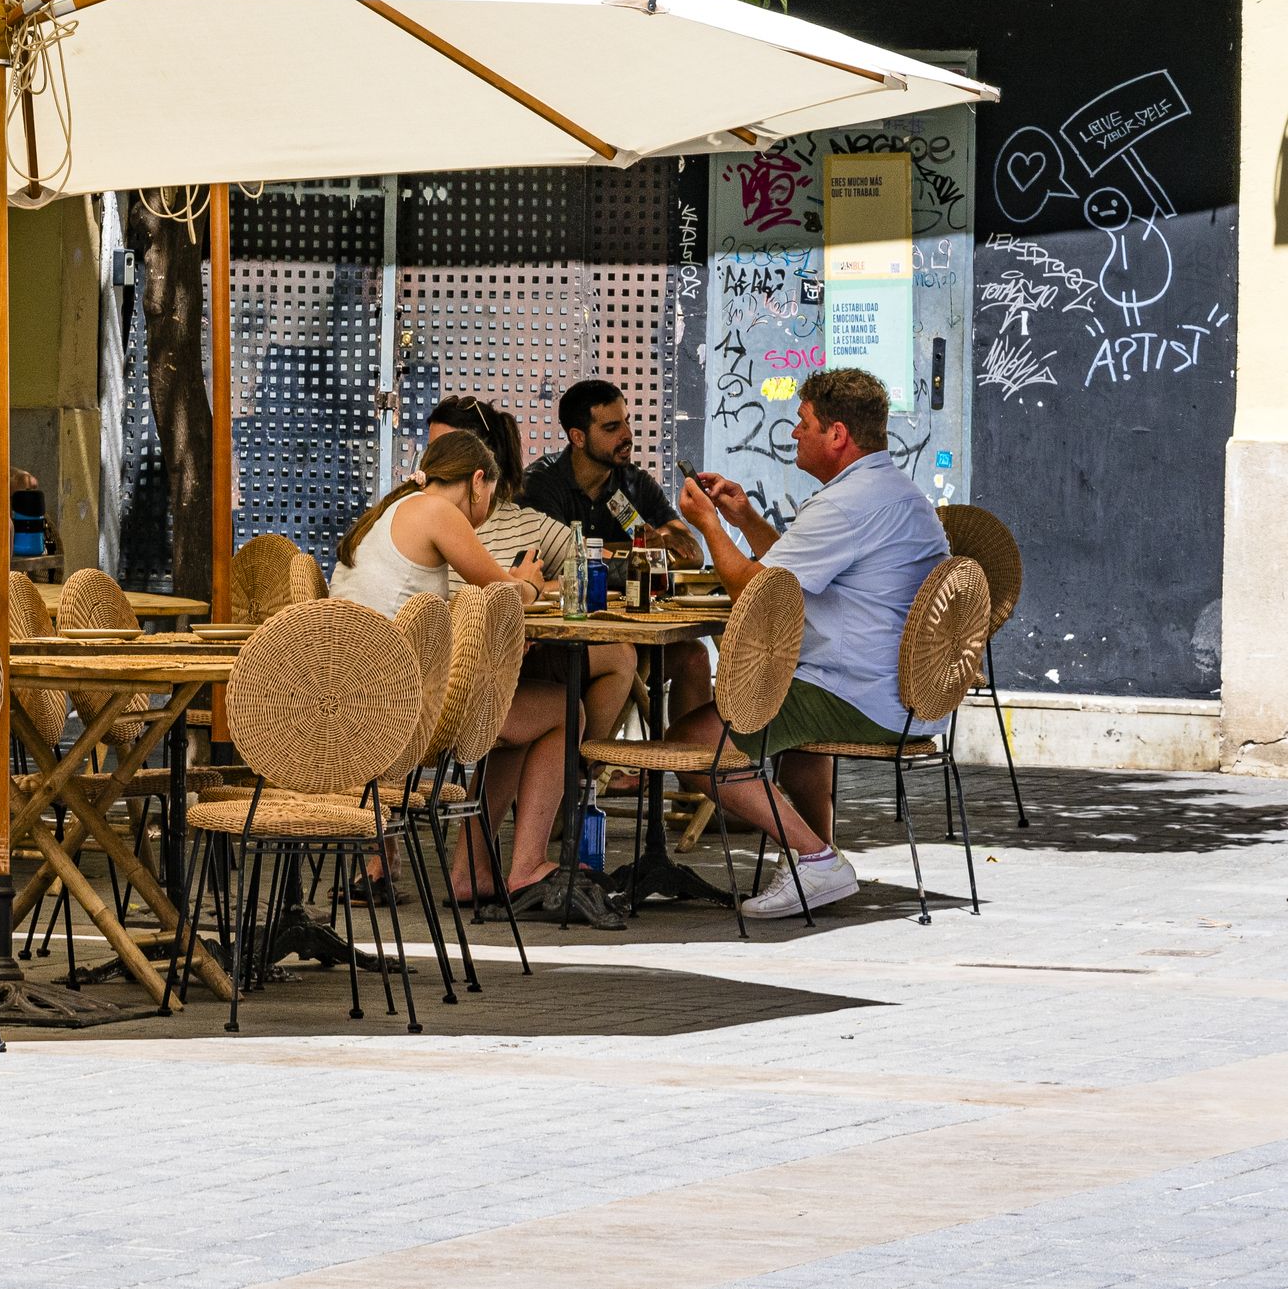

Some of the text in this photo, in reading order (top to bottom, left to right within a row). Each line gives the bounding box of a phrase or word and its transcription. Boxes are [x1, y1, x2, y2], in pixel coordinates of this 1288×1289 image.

[1079, 111, 1123, 143] LOVE
[831, 175, 883, 187] ERES MUCHO MÁS
[831, 188, 881, 198] QUE TU TRABAJO.
[832, 303, 879, 312] LA ESTABILIDAD
[832, 314, 875, 323] EMOCIONAL VA
[832, 324, 877, 334] DE LA MANO DE
[833, 335, 879, 345] LA ESTABILIDAD
[833, 345, 869, 355] ECONÓMICA.
